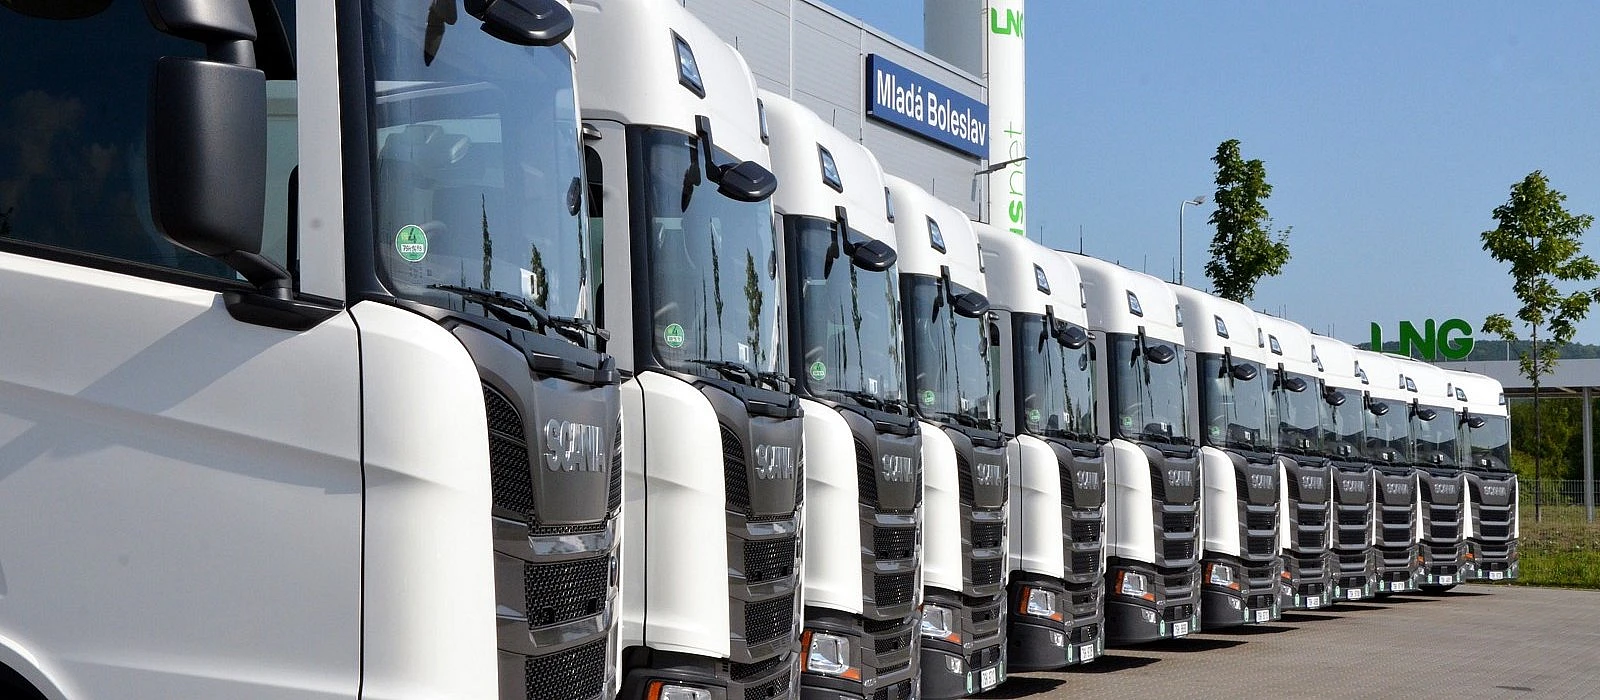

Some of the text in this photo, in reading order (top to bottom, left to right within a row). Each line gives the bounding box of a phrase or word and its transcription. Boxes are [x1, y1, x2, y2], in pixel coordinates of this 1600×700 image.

[876, 69, 987, 147] Mladá Boleslav
[1370, 318, 1474, 360] LNG
[545, 418, 606, 473] SCANIA
[756, 444, 794, 480] SCANIA
[882, 454, 914, 483] SCANIA
